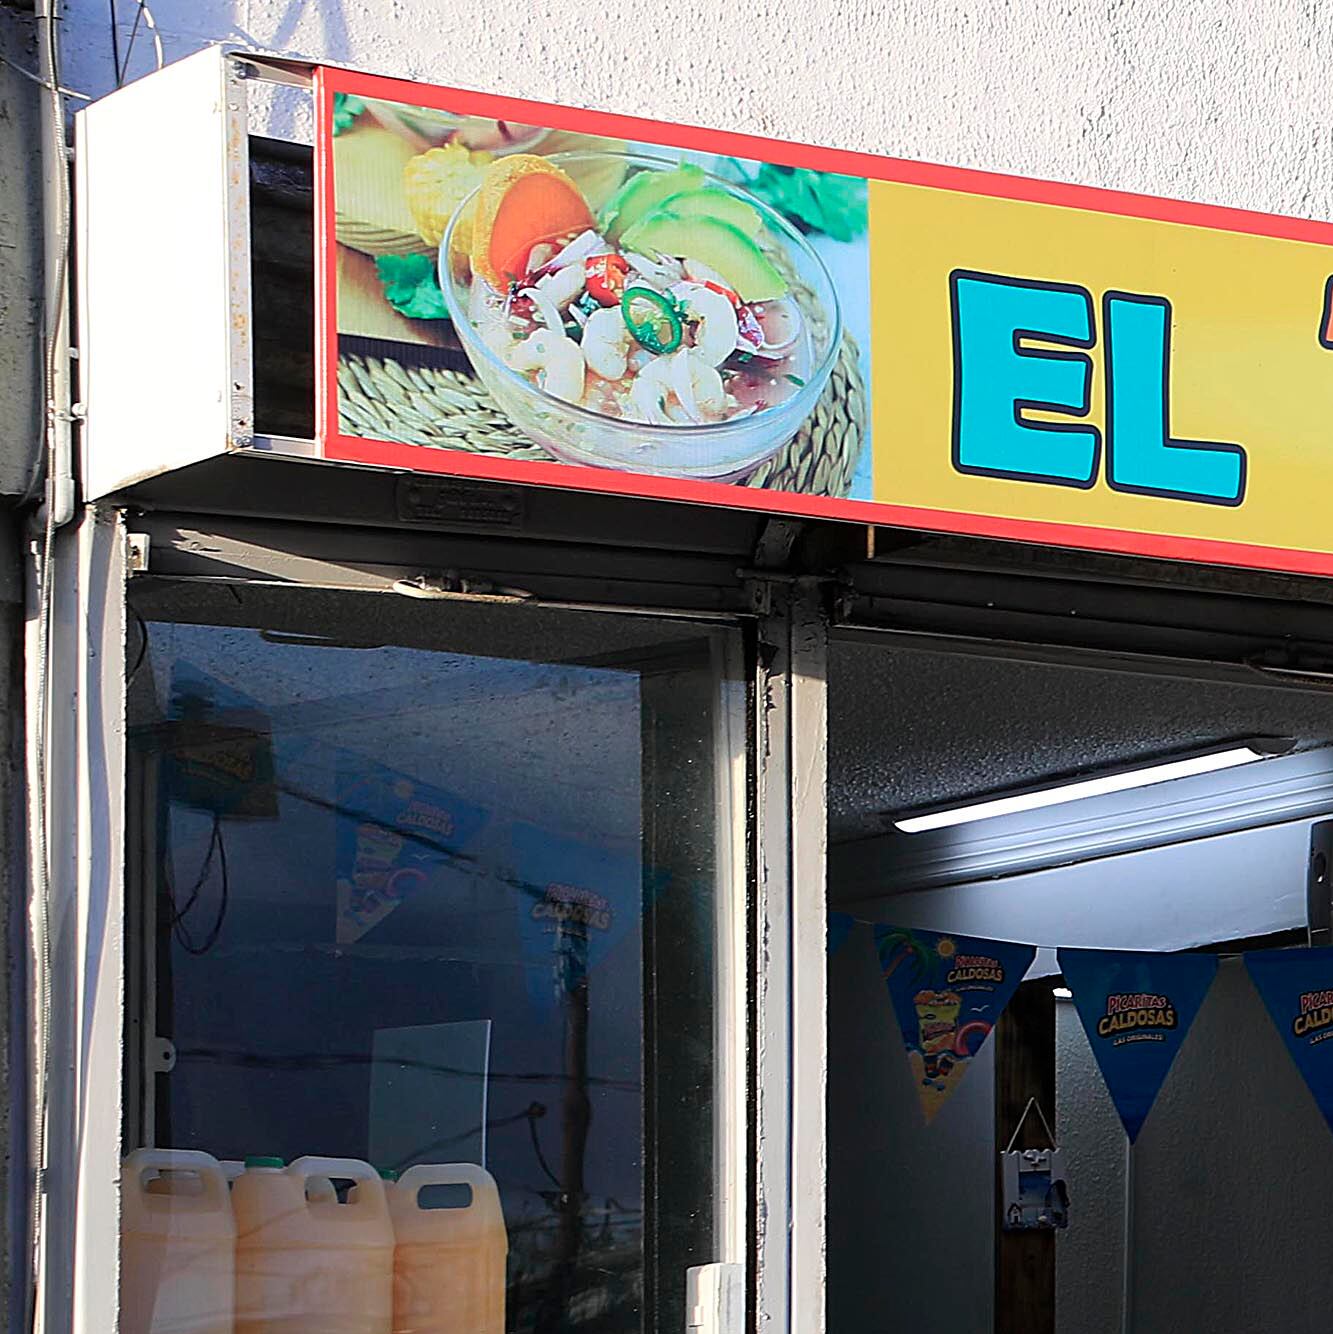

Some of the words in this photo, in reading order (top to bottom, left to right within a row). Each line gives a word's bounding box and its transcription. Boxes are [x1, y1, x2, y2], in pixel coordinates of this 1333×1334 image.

[949, 269, 1247, 507] EL
[947, 967, 1003, 982] CALDOSAS
[1107, 994, 1167, 1015] PICARITAS
[1099, 1009, 1175, 1035] CALDOSAS
